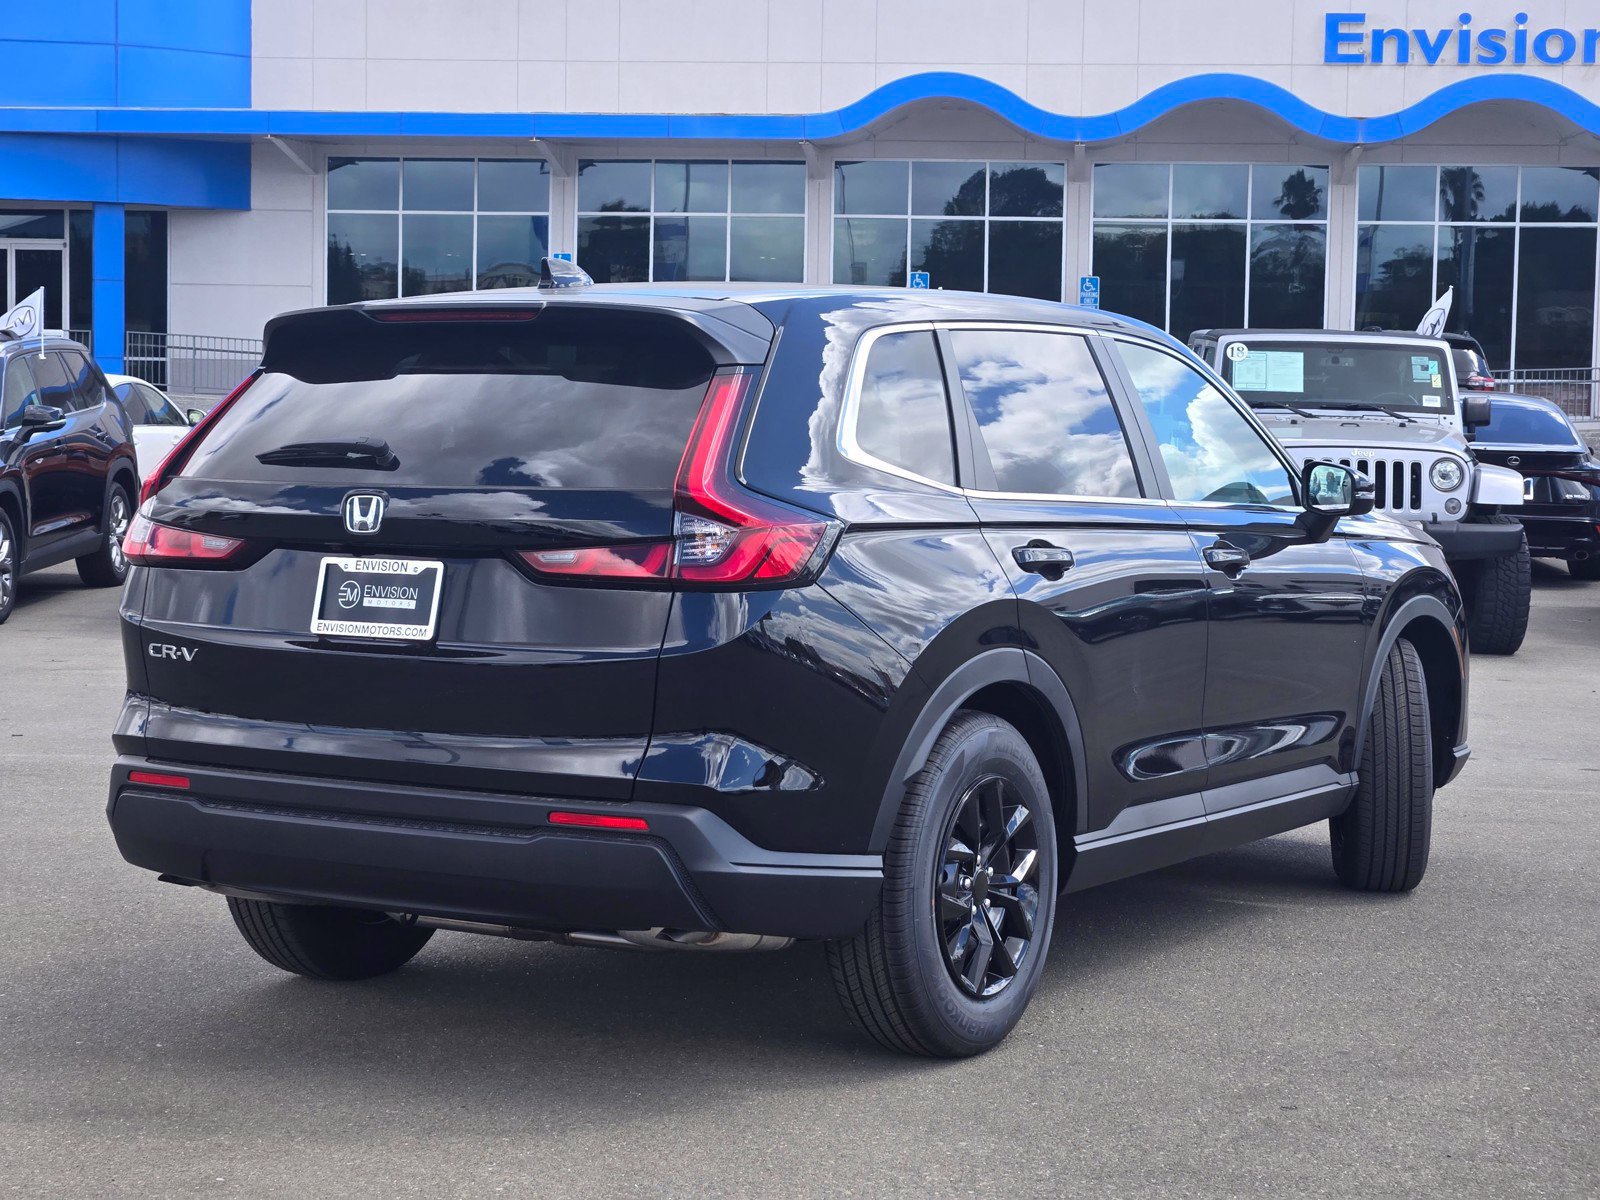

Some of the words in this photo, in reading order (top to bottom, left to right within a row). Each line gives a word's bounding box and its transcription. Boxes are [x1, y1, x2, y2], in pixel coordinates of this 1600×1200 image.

[1230, 346, 1245, 358] 18
[1351, 448, 1375, 458] Jeep
[355, 560, 408, 572] ENVISION
[363, 585, 418, 600] ENVISION
[316, 622, 428, 638] ENVISIONMOTORS.COM
[148, 643, 199, 661] CR-V
